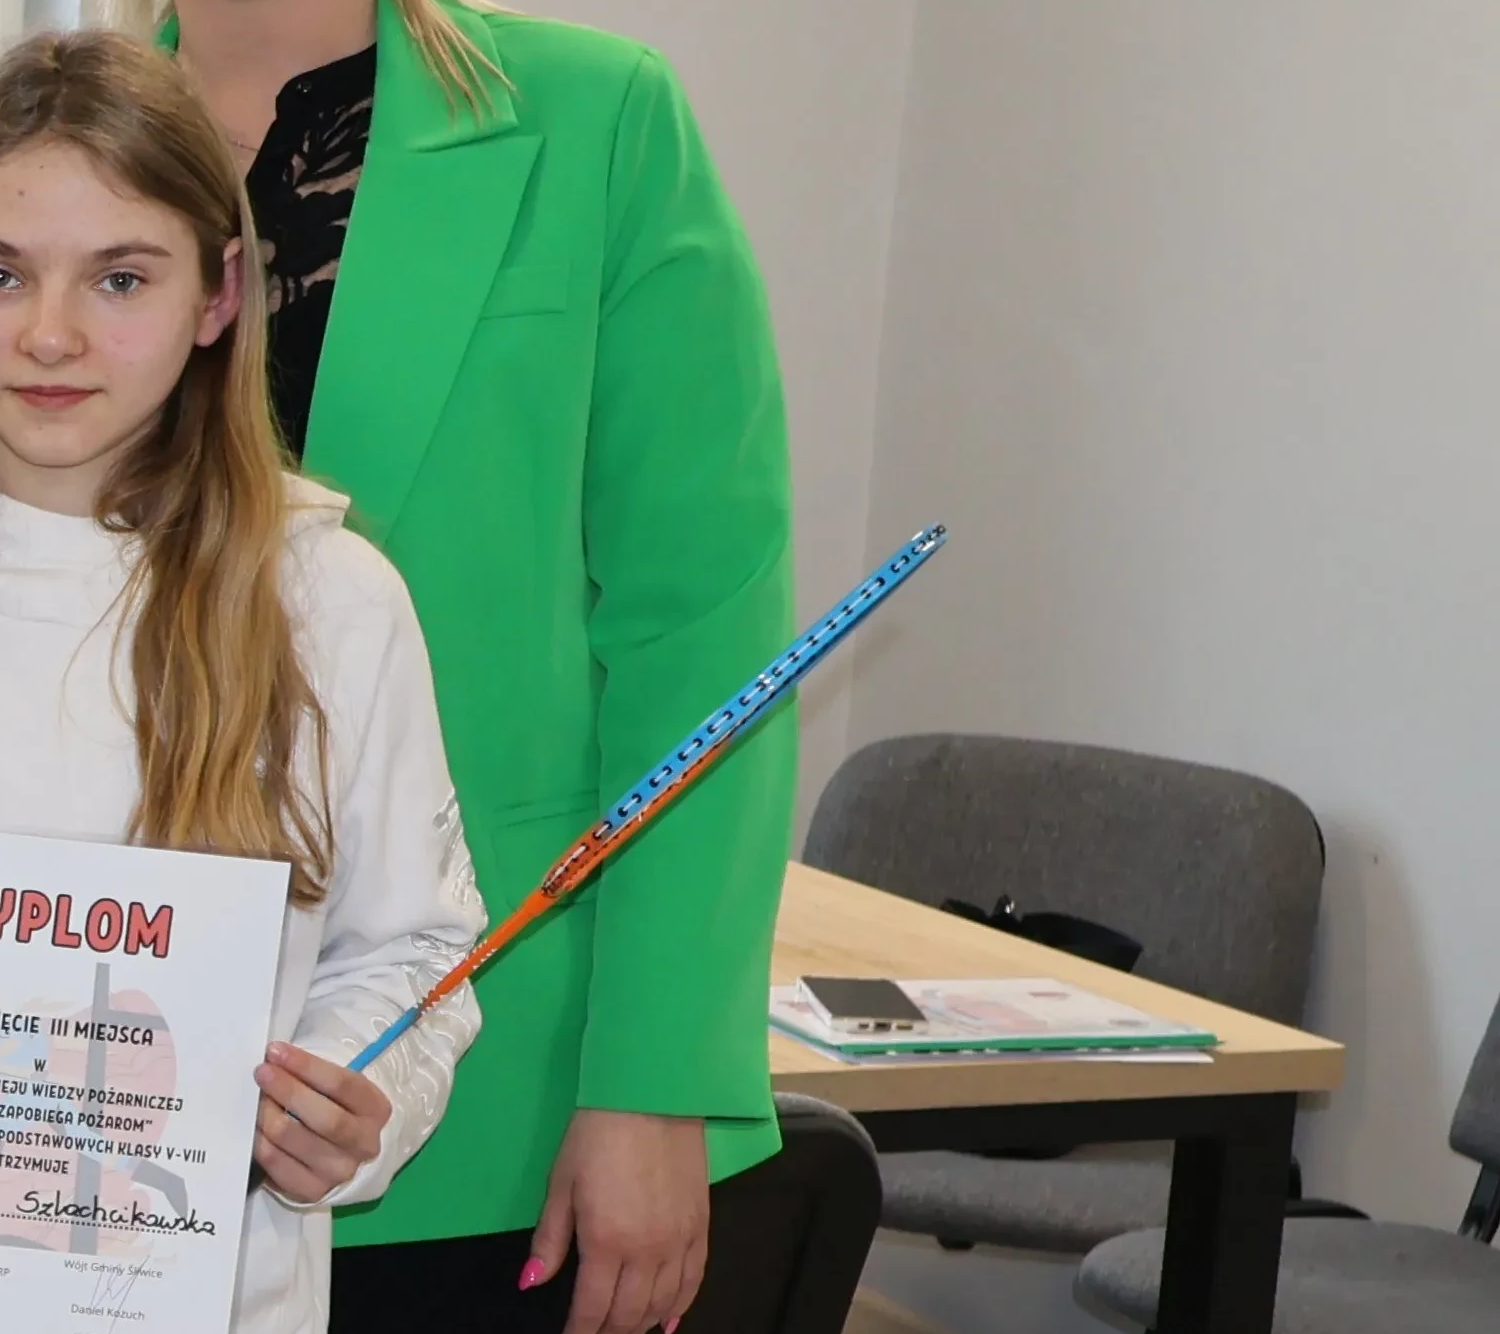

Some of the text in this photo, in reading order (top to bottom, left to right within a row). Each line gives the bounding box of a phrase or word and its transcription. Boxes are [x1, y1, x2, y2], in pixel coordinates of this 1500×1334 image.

[50, 1018, 69, 1036] III
[74, 1021, 154, 1046] MIEJSCA
[34, 1058, 46, 1072] W
[32, 1083, 85, 1101] WIEDZY
[87, 1087, 184, 1112] POŻARNICZEJ
[117, 1142, 162, 1159] KLASY
[166, 1147, 206, 1164] V-VIII
[64, 1259, 88, 1273] Wójt
[70, 1304, 104, 1316] Daniel
